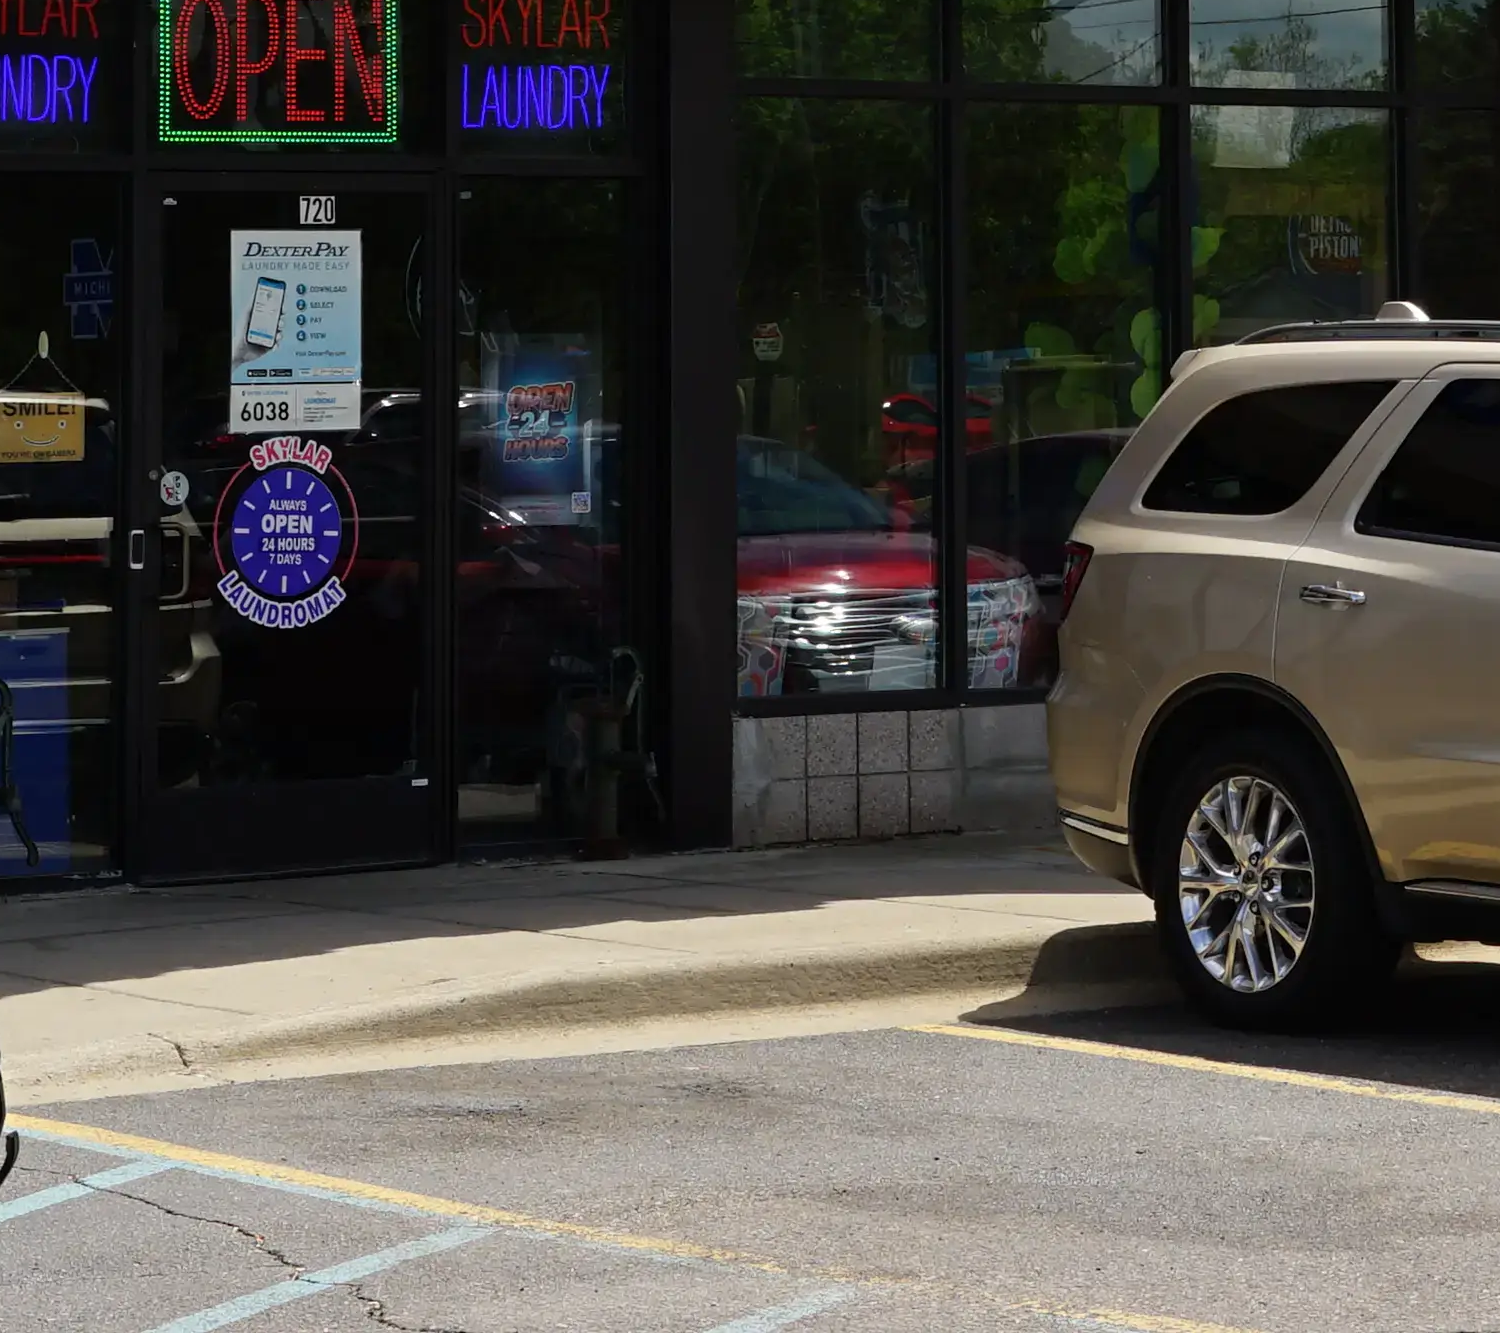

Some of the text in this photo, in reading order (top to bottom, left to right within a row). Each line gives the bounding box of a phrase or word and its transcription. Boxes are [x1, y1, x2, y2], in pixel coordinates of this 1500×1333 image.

[462, 64, 611, 129] LAUNDRY
[301, 197, 335, 223] 720
[1309, 235, 1361, 259] PISTON
[241, 262, 350, 271] LAUNDRY MADE EASY
[310, 285, 347, 293] DOWNLOAD
[310, 301, 334, 309] SELECT
[2, 399, 76, 416] SMILE!
[506, 382, 574, 414] OPEN
[240, 401, 290, 422] 6038
[250, 436, 332, 474] SKYLAR
[504, 435, 569, 462] HOURS
[269, 499, 307, 511] ALWAYS
[261, 514, 313, 534] OPEN
[261, 537, 315, 552] 24 HOURS
[269, 553, 302, 565] 7 DAYS
[218, 570, 346, 628] LAUNDROMAT
